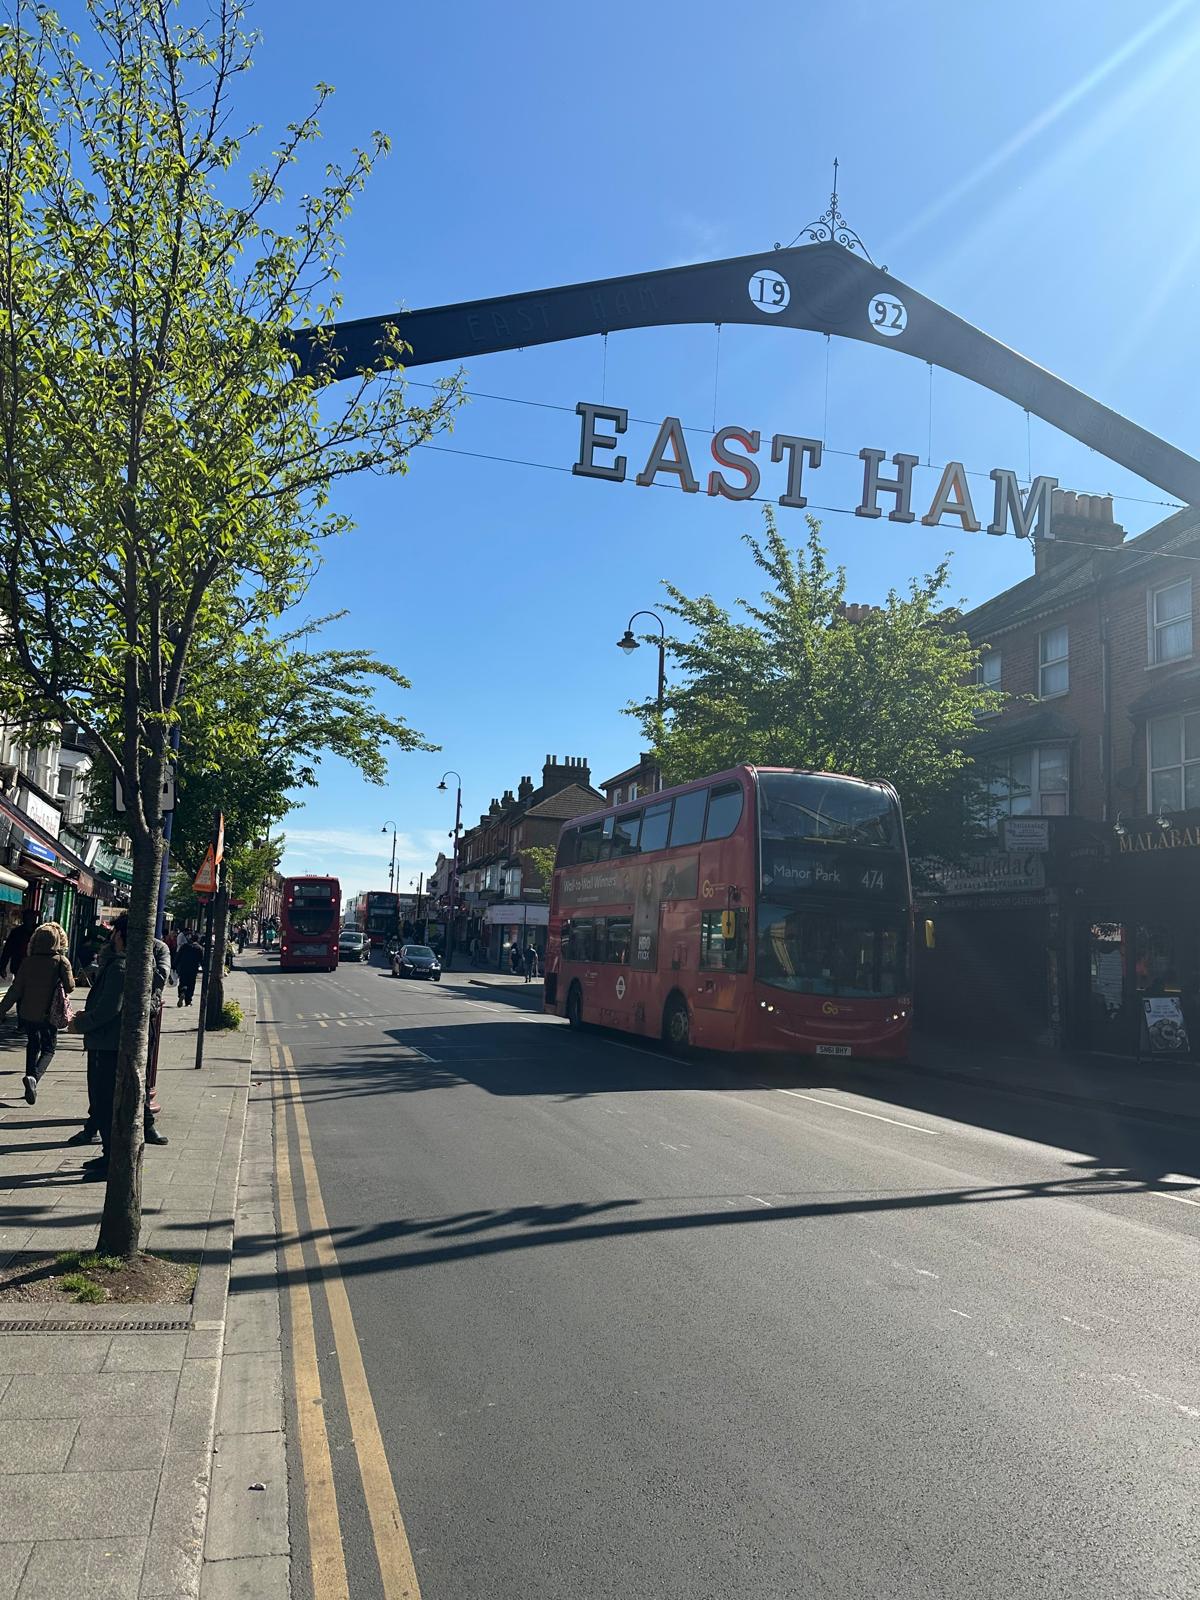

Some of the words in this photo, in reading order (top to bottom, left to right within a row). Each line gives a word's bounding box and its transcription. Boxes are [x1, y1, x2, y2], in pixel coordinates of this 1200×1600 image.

[758, 277, 785, 305] 19
[466, 302, 552, 345] EAST
[590, 287, 658, 321] HAM
[874, 301, 903, 329] 92
[572, 402, 822, 508] EAST
[855, 447, 1059, 540] HAM
[702, 879, 714, 898] Go
[773, 864, 812, 879] Manor
[815, 868, 841, 882] Park
[861, 870, 884, 889] 474
[638, 936, 650, 950] HBO
[822, 1001, 839, 1015] Go
